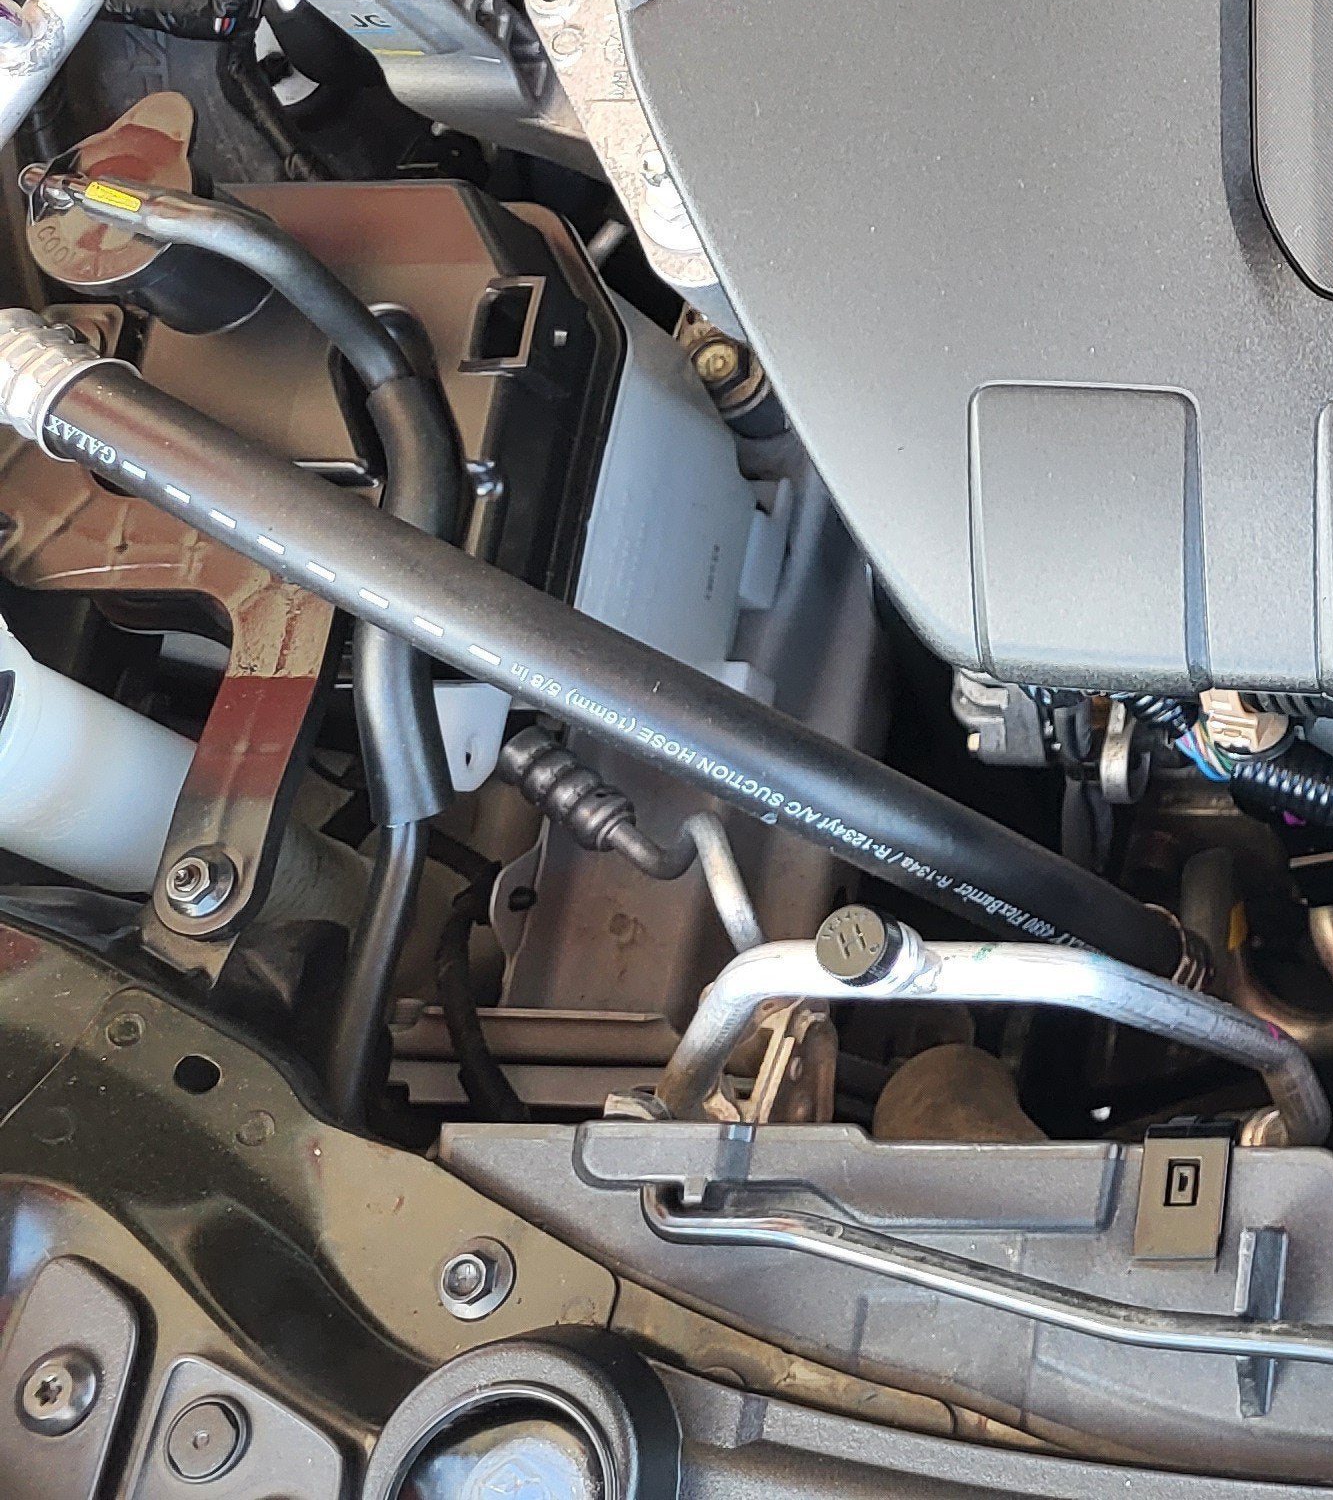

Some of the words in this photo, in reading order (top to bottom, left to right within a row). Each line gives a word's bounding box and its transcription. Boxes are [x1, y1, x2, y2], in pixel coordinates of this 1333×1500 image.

[45, 416, 116, 464] GALAX
[527, 671, 563, 698] 5/8
[563, 686, 638, 734] (16mm)
[634, 724, 697, 765] HOSE
[695, 754, 787, 809] SUCTION
[782, 795, 821, 826] A/C
[821, 816, 891, 861] R-1234yf
[907, 854, 952, 889] R-134a
